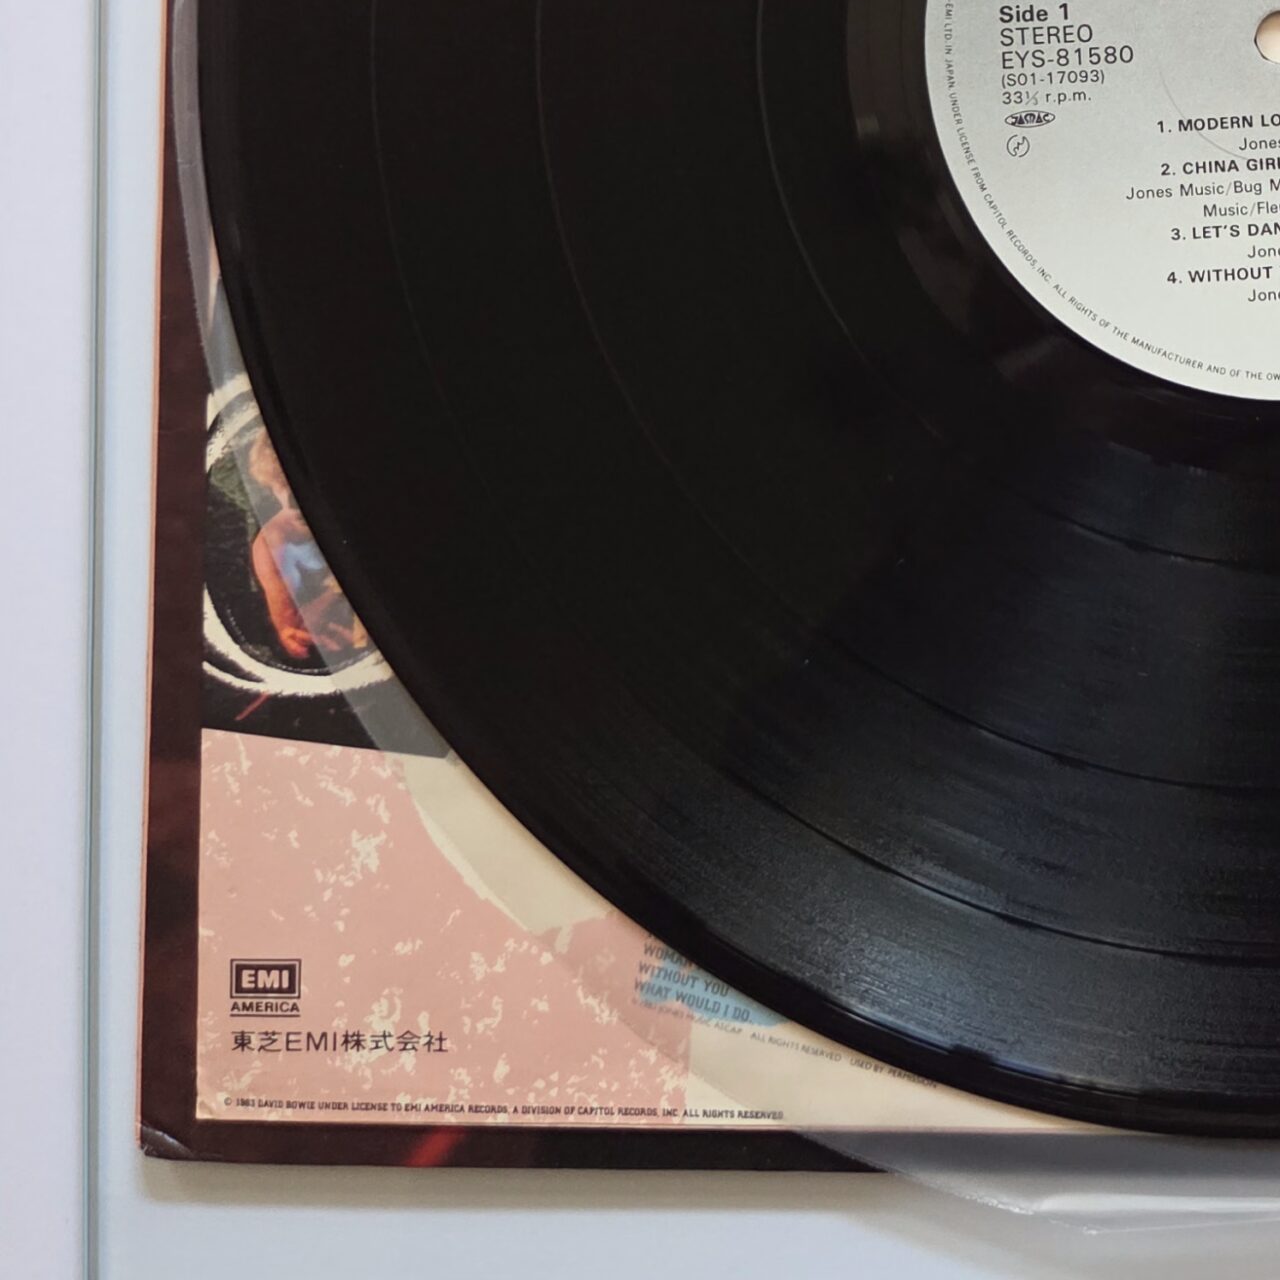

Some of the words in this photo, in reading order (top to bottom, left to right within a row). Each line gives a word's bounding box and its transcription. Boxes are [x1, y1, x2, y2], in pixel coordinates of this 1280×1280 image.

[999, 4, 1048, 23] Side
[1059, 3, 1068, 20] 1
[1000, 24, 1093, 47] STEREO
[1002, 45, 1133, 69] EYS-81580
[1002, 69, 1104, 89] (S01-17093)
[1046, 91, 1091, 105] r.p.m.
[1157, 120, 1171, 133] 1.
[1178, 115, 1253, 132] MODERN
[1161, 163, 1176, 176] 2.
[1183, 160, 1239, 175] CHINA
[1126, 187, 1172, 200] Jones
[1180, 180, 1262, 197] Music/Bug
[1171, 228, 1186, 240] 3.
[1192, 225, 1240, 239] LET'S
[1167, 272, 1182, 284] 4.
[1188, 266, 1273, 283] WITHOUT
[1129, 335, 1204, 371] MANUFACTURER
[1205, 362, 1227, 376] AND
[1228, 367, 1240, 378] OF
[1244, 369, 1263, 381] THE
[241, 969, 291, 990] EMI
[638, 961, 700, 989] WITHOUT
[703, 978, 731, 998] YOU
[634, 979, 670, 1000] WHAT
[675, 990, 721, 1014] WOULD
[230, 1001, 300, 1013] AMERICA
[231, 1029, 449, 1053] 東芝EMI株式会社
[258, 1099, 284, 1109] DAVID
[286, 1100, 316, 1110] BOWIE
[318, 1101, 349, 1111] UNDER
[351, 1102, 389, 1112] LICENSE
[391, 1103, 403, 1112] TO
[404, 1102, 422, 1113] EMI
[425, 1103, 466, 1113] AMERICA
[512, 1105, 520, 1115] A
[521, 1105, 562, 1115] DIVISION
[564, 1106, 576, 1116] OF
[577, 1106, 616, 1116] CAPITOL
[683, 1109, 701, 1118] ALL
[702, 1109, 735, 1119] RIGHTS
